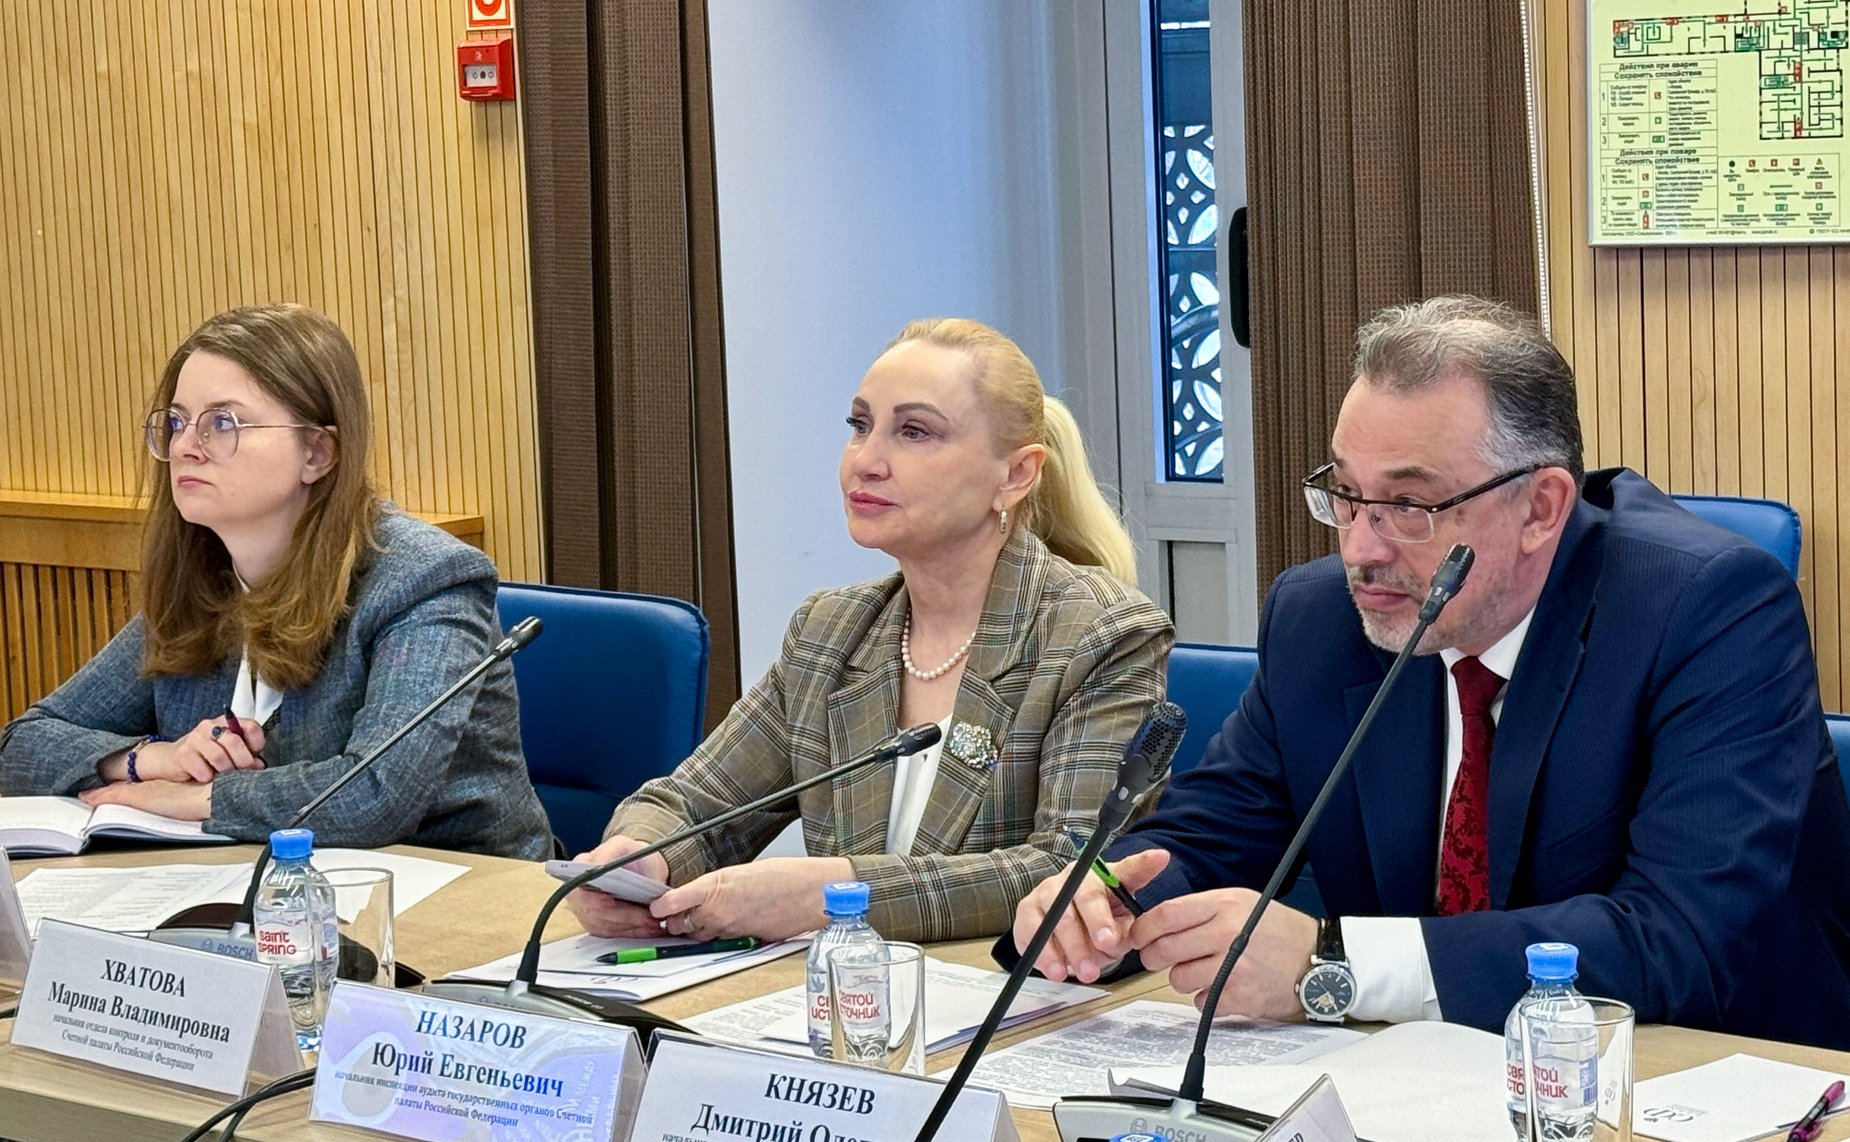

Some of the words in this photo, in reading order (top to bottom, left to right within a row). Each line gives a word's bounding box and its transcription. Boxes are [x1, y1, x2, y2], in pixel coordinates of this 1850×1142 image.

[217, 943, 254, 960] BOSCH
[100, 959, 185, 998] ХВАТОВА
[47, 981, 107, 1013] Марина
[109, 995, 231, 1043] Владимировна
[415, 1010, 527, 1049] НАЗАРОВ
[372, 1042, 434, 1076] Юрий
[438, 1053, 564, 1098] Евгеньевич
[419, 1084, 446, 1098] аудита
[520, 1104, 554, 1117] органов
[424, 1100, 469, 1118] Российской
[471, 1109, 518, 1127] Федерации
[764, 1073, 876, 1115] КНЯЗЕВ
[690, 1103, 804, 1142] Дмитрий
